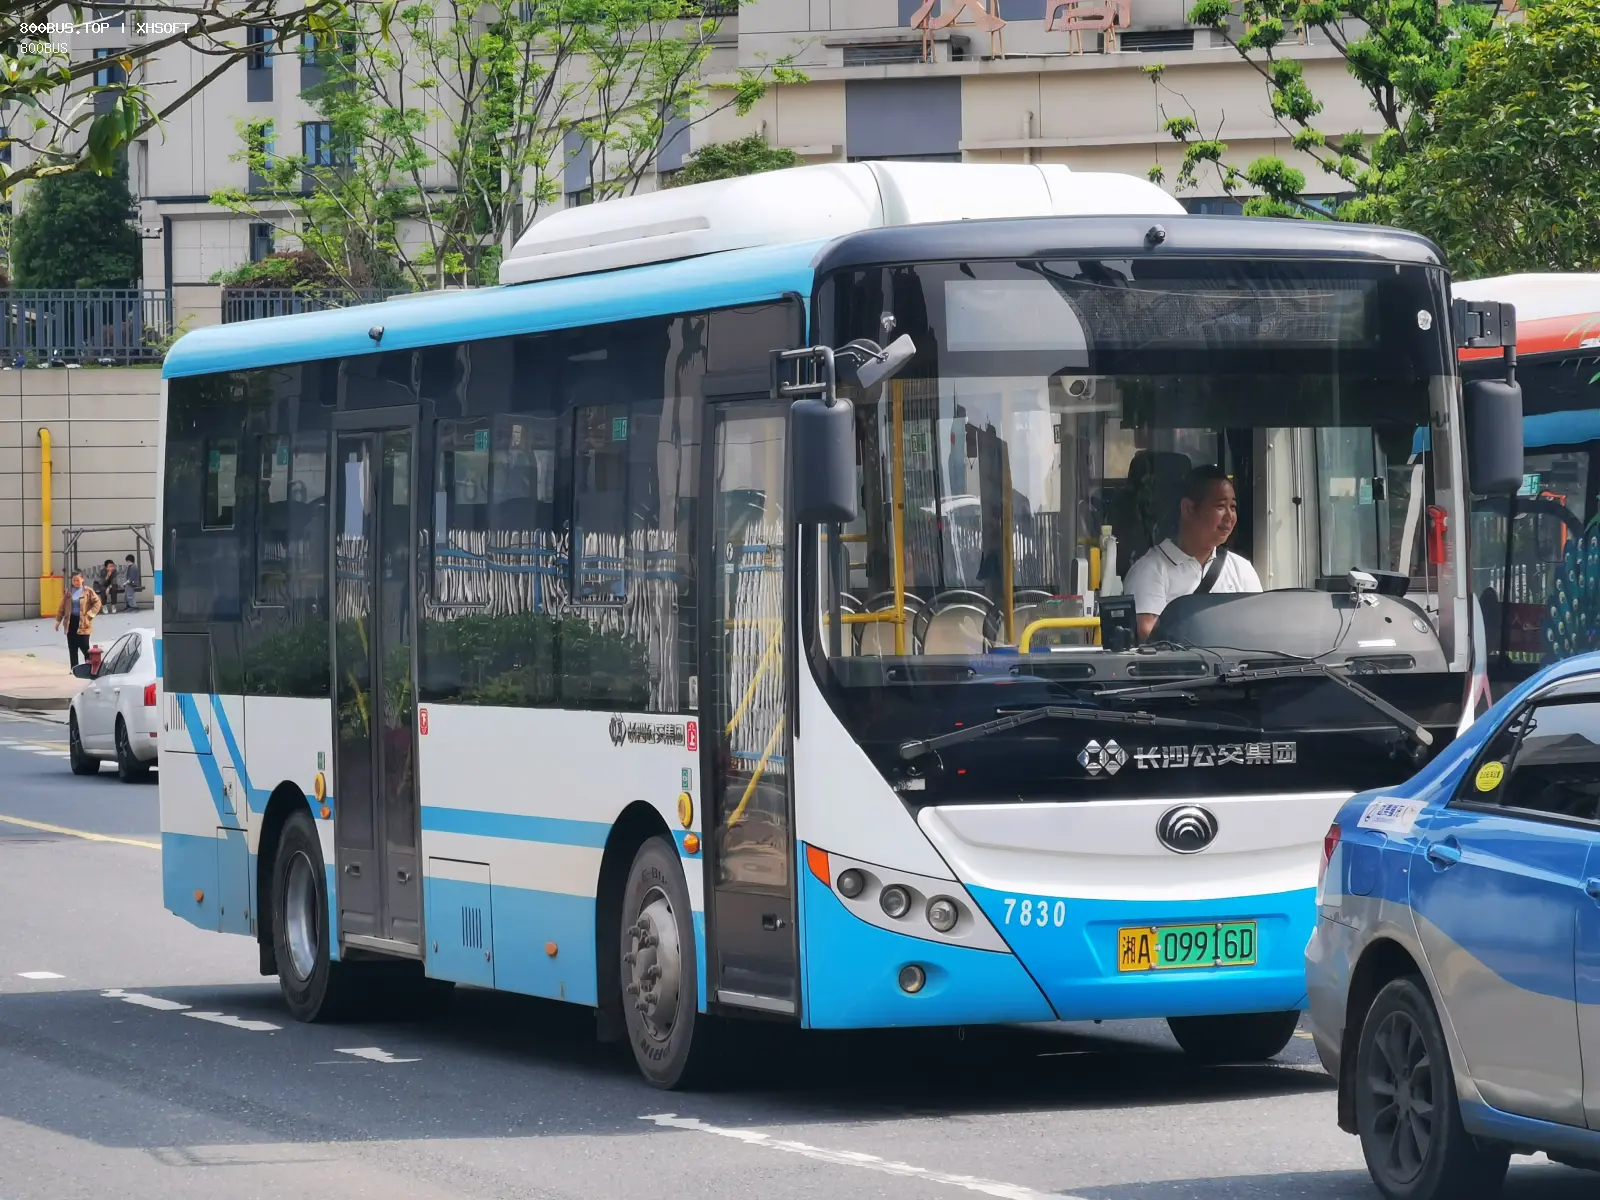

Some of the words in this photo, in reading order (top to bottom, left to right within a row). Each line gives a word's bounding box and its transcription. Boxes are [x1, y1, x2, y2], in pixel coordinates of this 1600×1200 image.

[1133, 741, 1297, 769] 长沙公交集团
[1003, 898, 1066, 928] 7830
